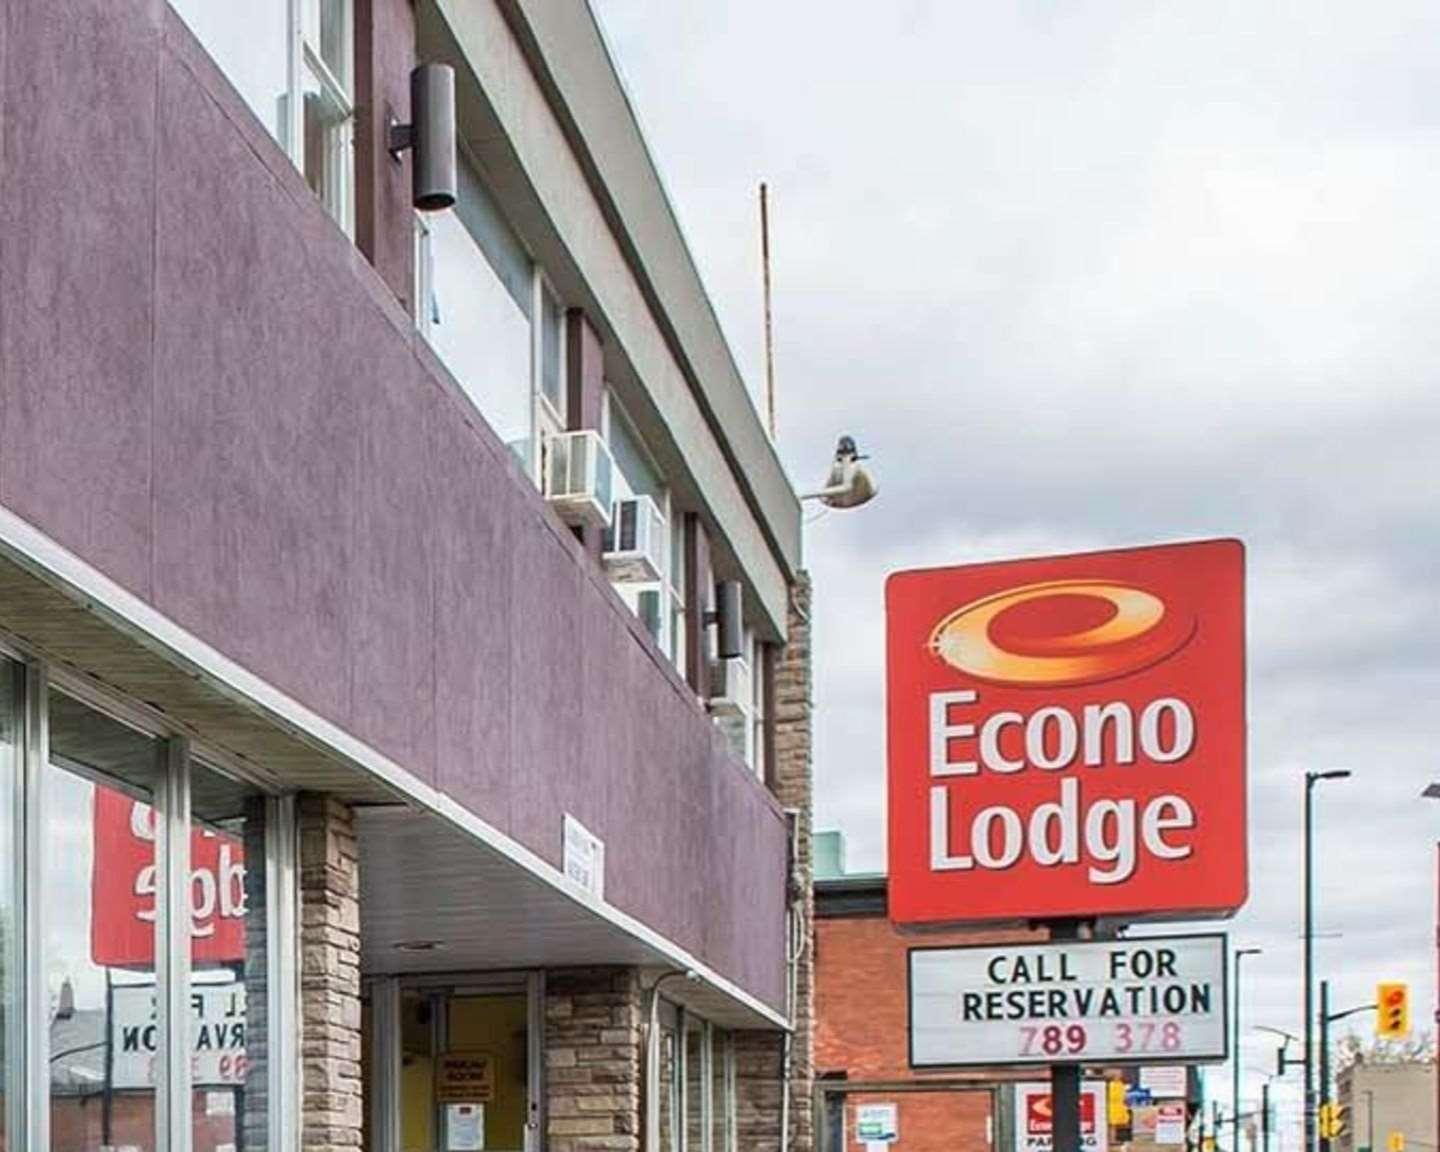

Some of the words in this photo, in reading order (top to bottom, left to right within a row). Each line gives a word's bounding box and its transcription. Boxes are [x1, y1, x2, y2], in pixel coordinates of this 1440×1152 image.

[929, 690, 1195, 777] Econo
[930, 777, 1195, 884] Lodge
[987, 953, 1078, 984] CALL
[1110, 949, 1177, 979] FOR
[962, 984, 1211, 1021] RESERVATION
[1018, 1025, 1087, 1056] 789
[1115, 1022, 1182, 1053] 378
